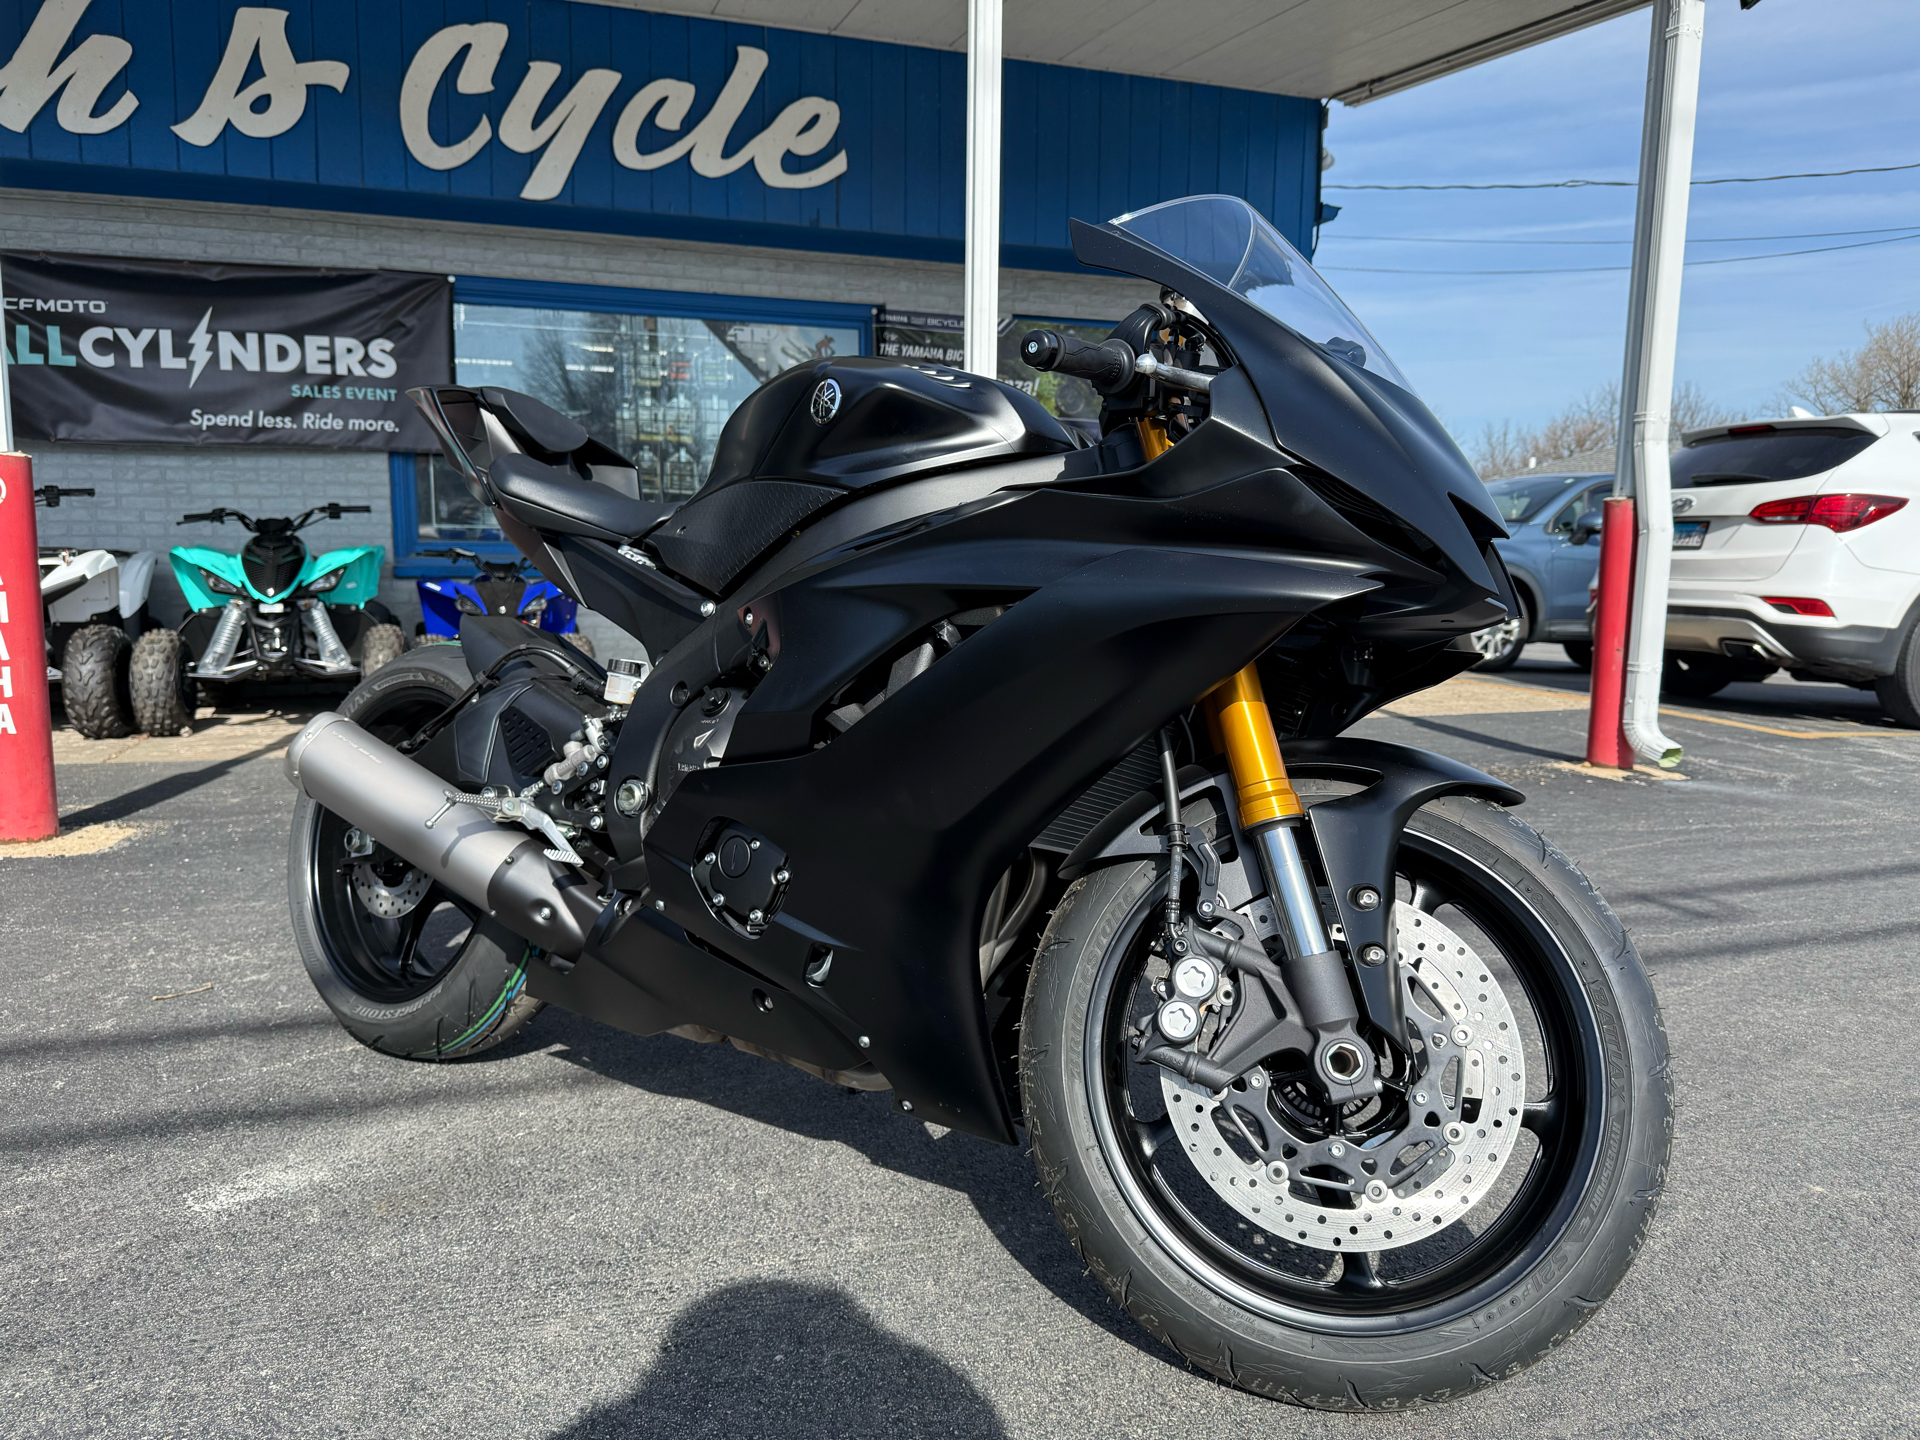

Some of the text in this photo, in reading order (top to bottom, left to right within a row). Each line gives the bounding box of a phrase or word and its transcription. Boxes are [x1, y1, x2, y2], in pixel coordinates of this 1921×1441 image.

[400, 22, 848, 201] Cycle
[3, 298, 106, 313] CFMOTO
[879, 343, 899, 355] THE
[901, 345, 943, 360] YAMAHA
[291, 384, 397, 402] SALES EVENT
[190, 409, 399, 433] Spend less. Ride more.
[352, 981, 446, 1020] BRIDGESTONE
[1070, 886, 1136, 1084] BRIDGESTONE
[1590, 1122, 1621, 1216] HYPERSPORT
